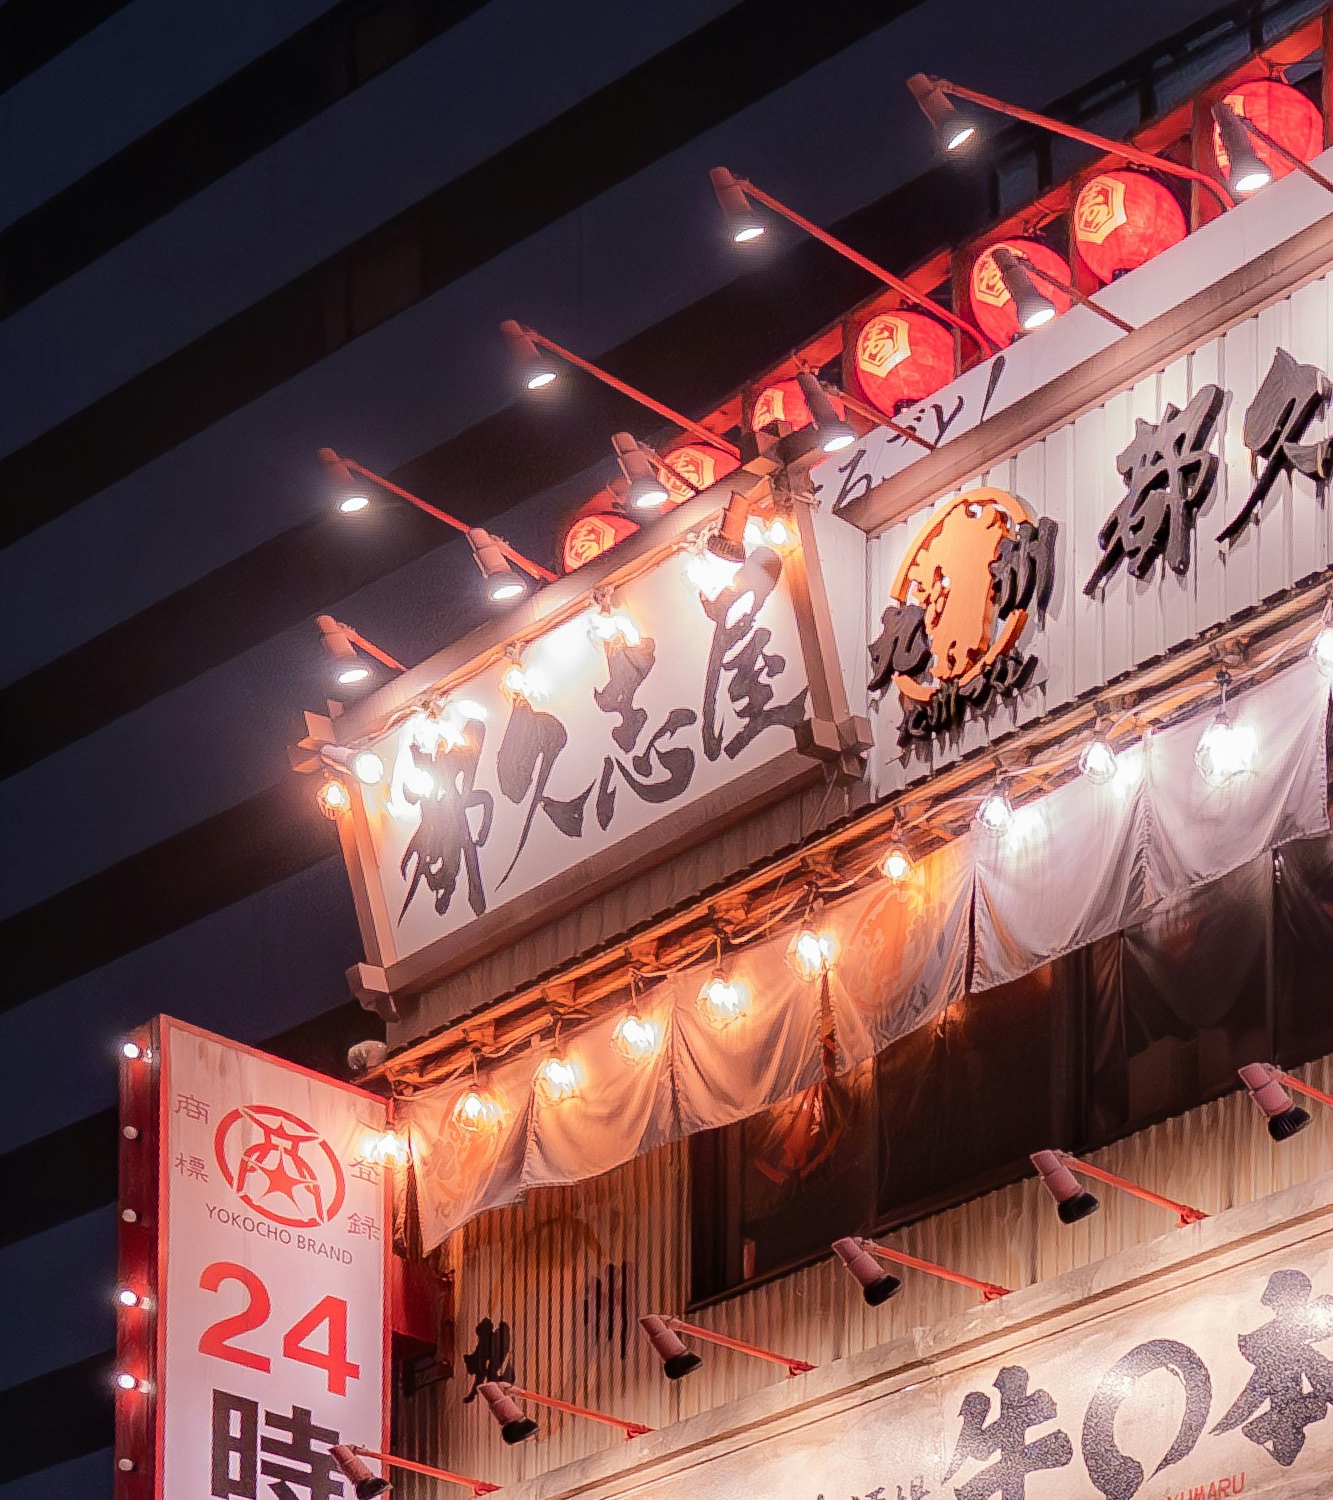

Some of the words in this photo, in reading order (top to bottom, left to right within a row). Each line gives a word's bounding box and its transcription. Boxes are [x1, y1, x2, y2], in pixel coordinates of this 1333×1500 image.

[175, 1093, 209, 1184] 商標
[207, 1202, 292, 1246] YOKOCHO
[296, 1234, 353, 1267] BRAND
